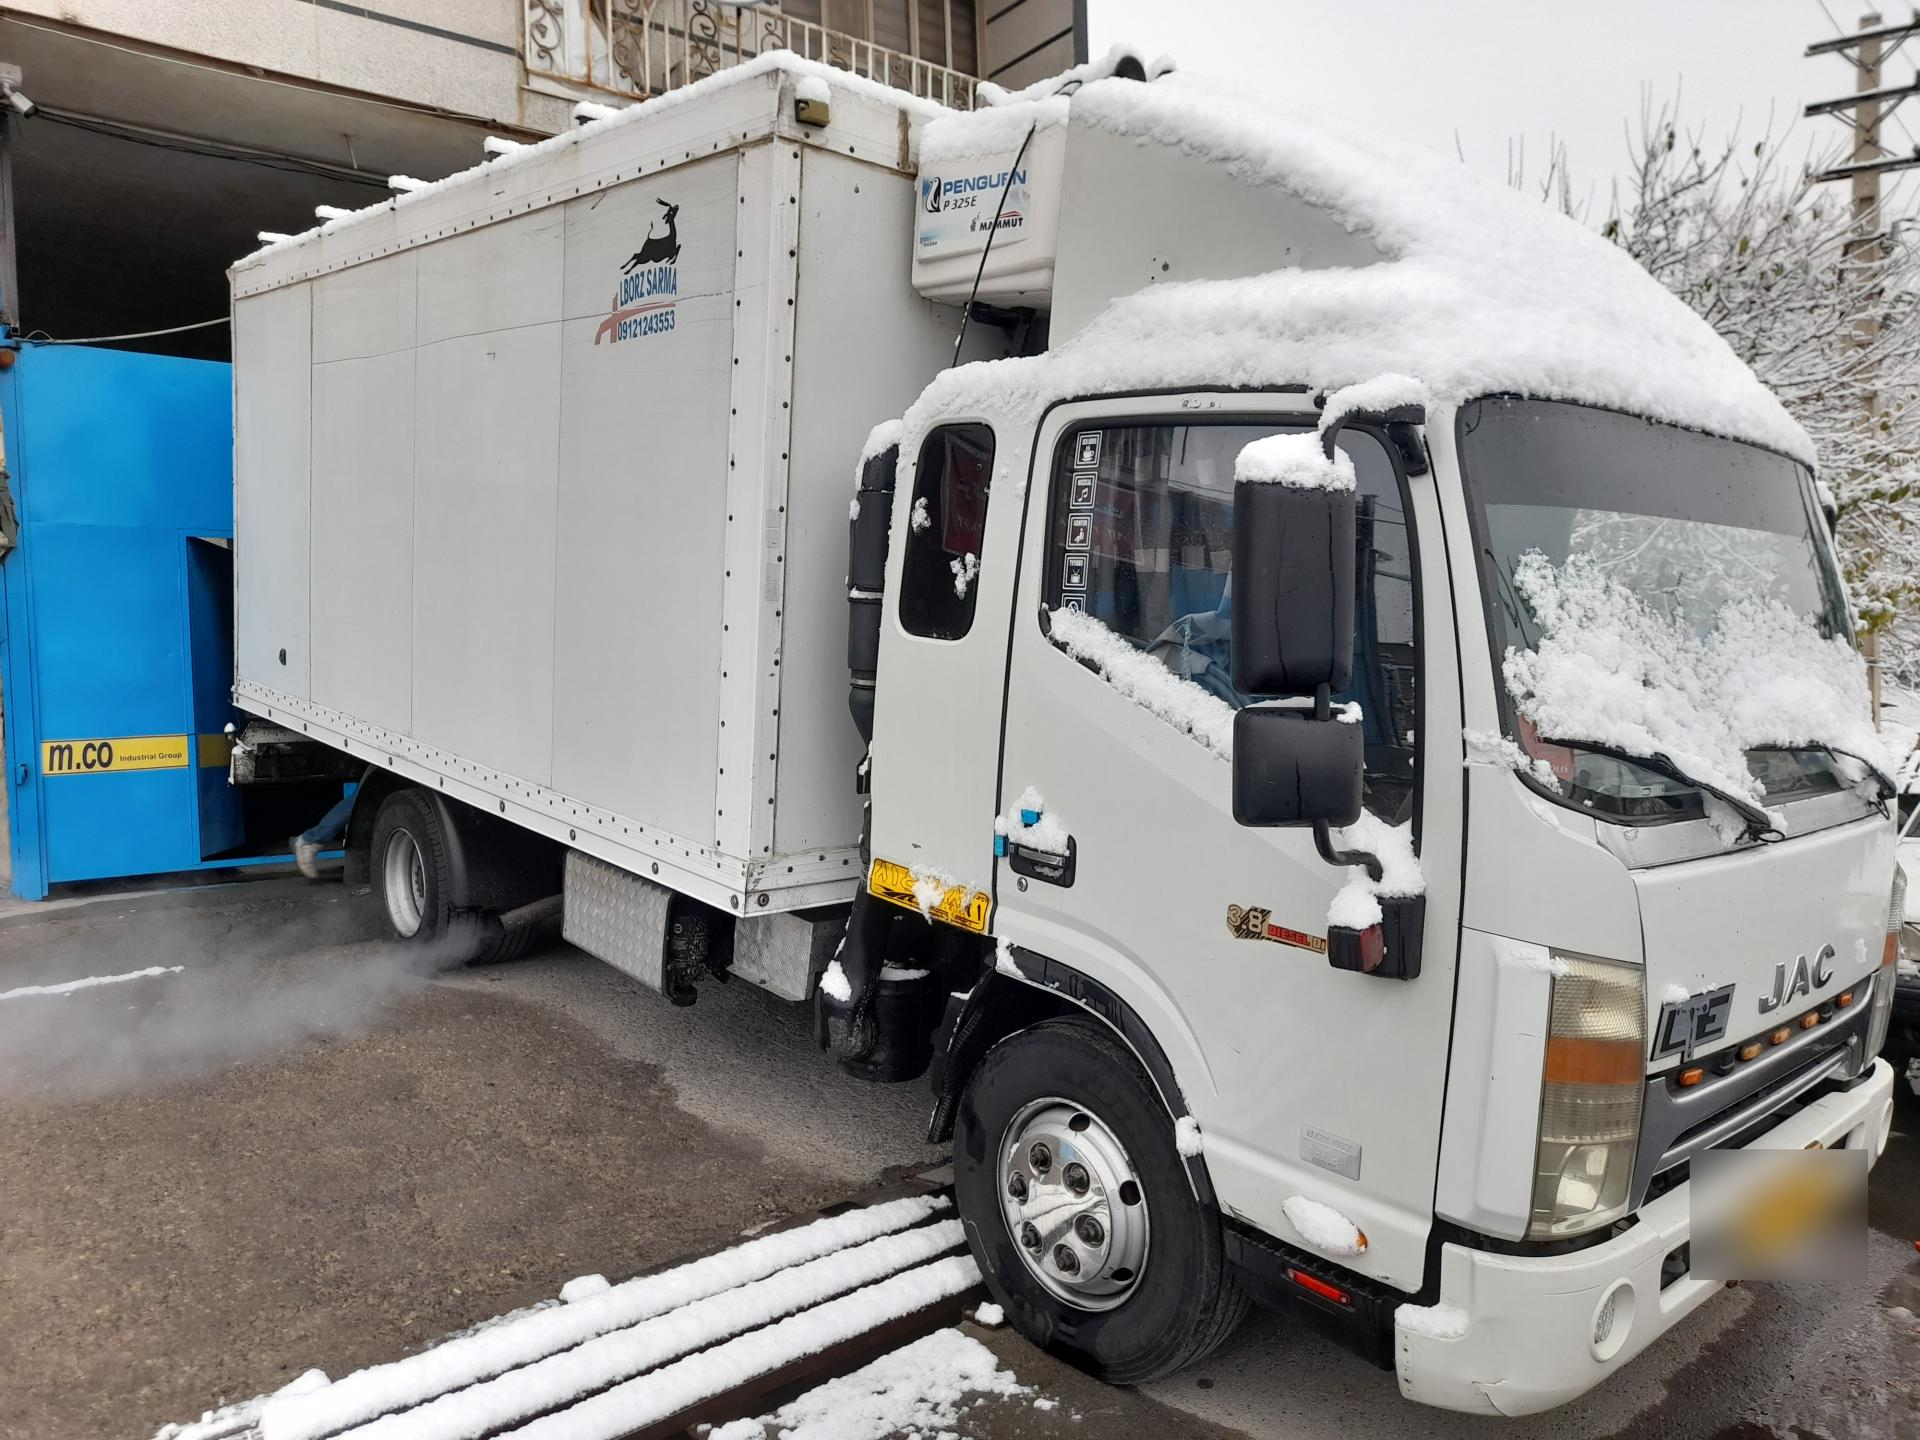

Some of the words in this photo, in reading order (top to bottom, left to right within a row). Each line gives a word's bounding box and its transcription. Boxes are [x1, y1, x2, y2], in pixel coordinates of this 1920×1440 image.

[943, 200, 951, 211] P
[951, 196, 978, 210] 325E
[979, 217, 1024, 232] MAMMUT
[646, 267, 678, 297] SARMA
[617, 309, 675, 342] 09121243553
[119, 754, 157, 762] Industrial
[158, 752, 183, 761] Group
[1227, 904, 1264, 935] 3.8
[1268, 925, 1311, 945] DIESEL
[1758, 942, 1836, 1015] JAC
